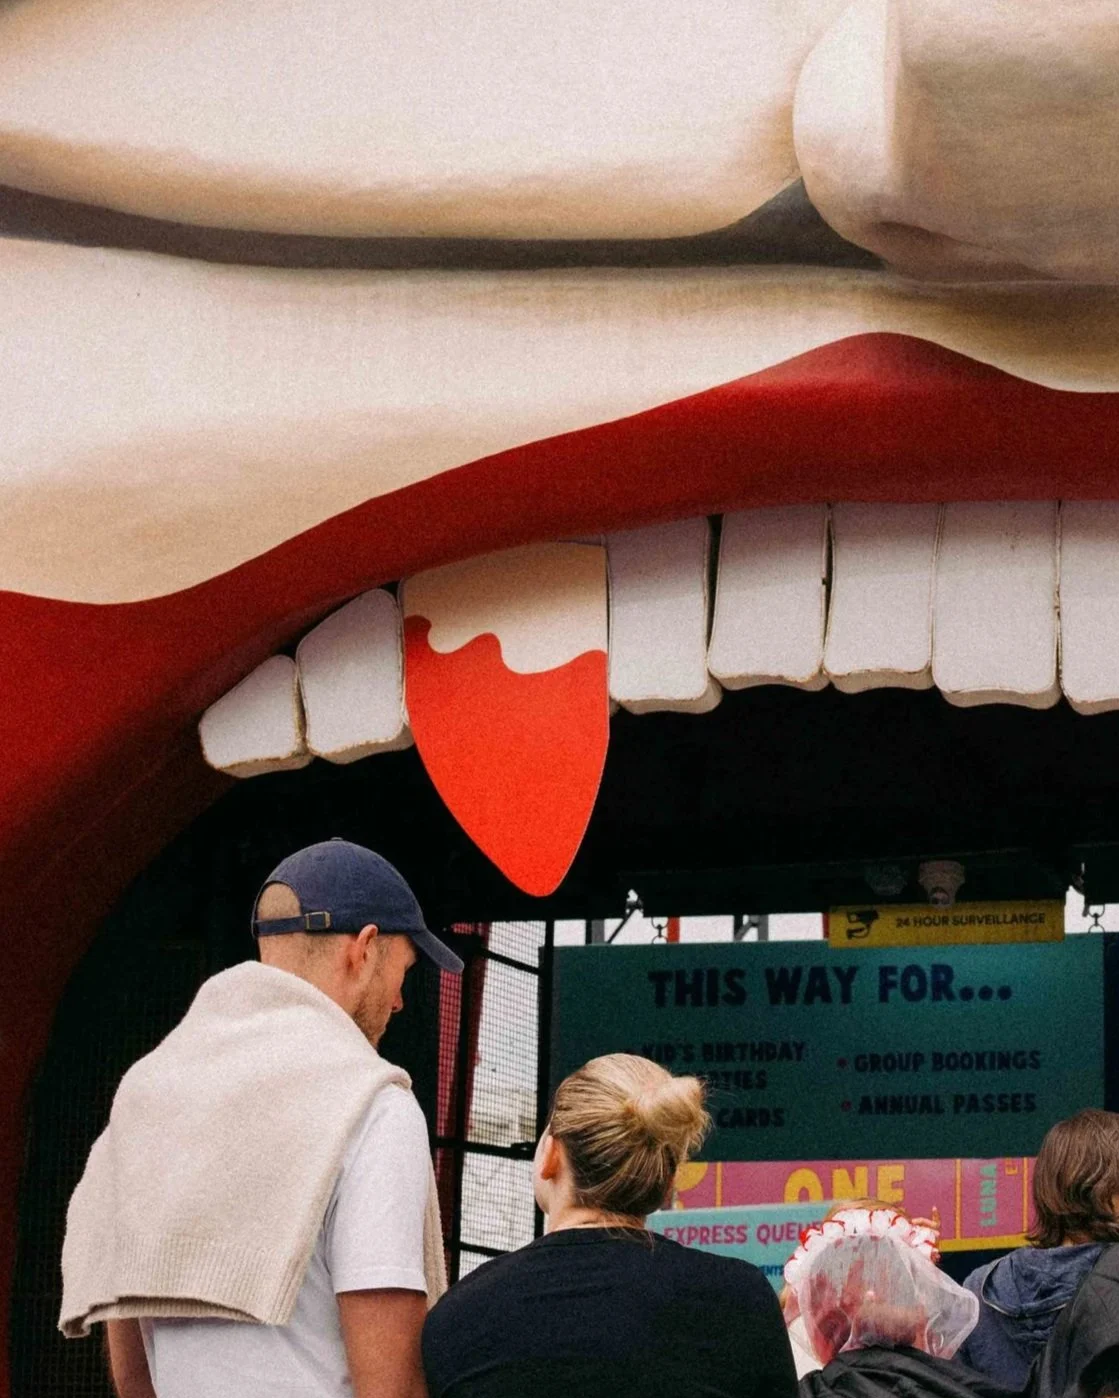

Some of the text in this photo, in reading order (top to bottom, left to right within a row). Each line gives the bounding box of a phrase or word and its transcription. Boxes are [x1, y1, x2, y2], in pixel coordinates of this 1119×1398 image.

[896, 912, 1047, 929] 24 HOUR SURVEILLANCE
[648, 963, 1013, 1008] THIS WAY FOR...
[700, 1040, 806, 1063] BIRTHDAY
[853, 1049, 1042, 1074] GROUP BOOKINGS
[858, 1093, 1037, 1116] ANNUAL PASSES
[716, 1106, 786, 1129] CARDS
[785, 1165, 906, 1205] ONE
[980, 1163, 997, 1228] LUNA
